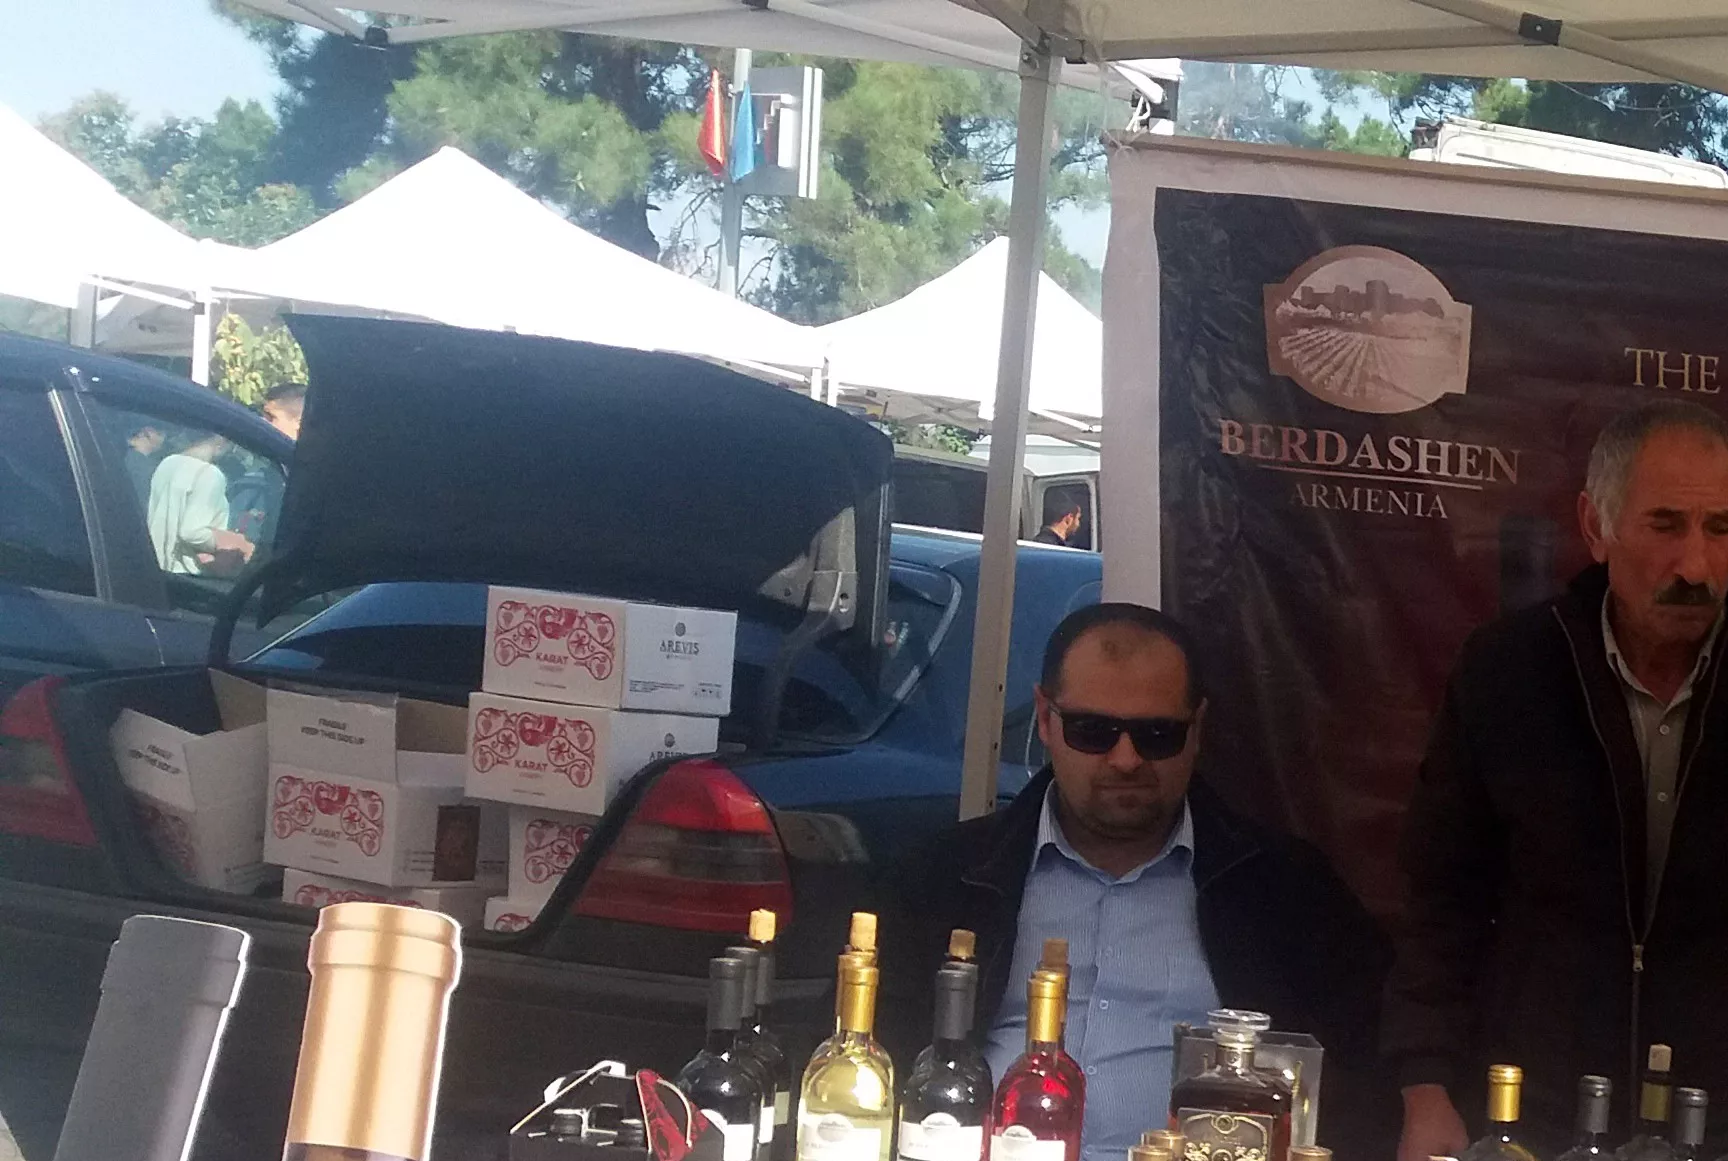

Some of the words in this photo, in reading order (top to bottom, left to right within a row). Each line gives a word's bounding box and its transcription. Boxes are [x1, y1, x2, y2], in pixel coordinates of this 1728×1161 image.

[1623, 346, 1721, 395] THE
[1217, 417, 1521, 485] BERDASHEN
[1288, 482, 1449, 520] ARMENIA
[535, 652, 569, 666] KARAT
[659, 639, 700, 655] AREVIS
[513, 759, 549, 772] KARAT
